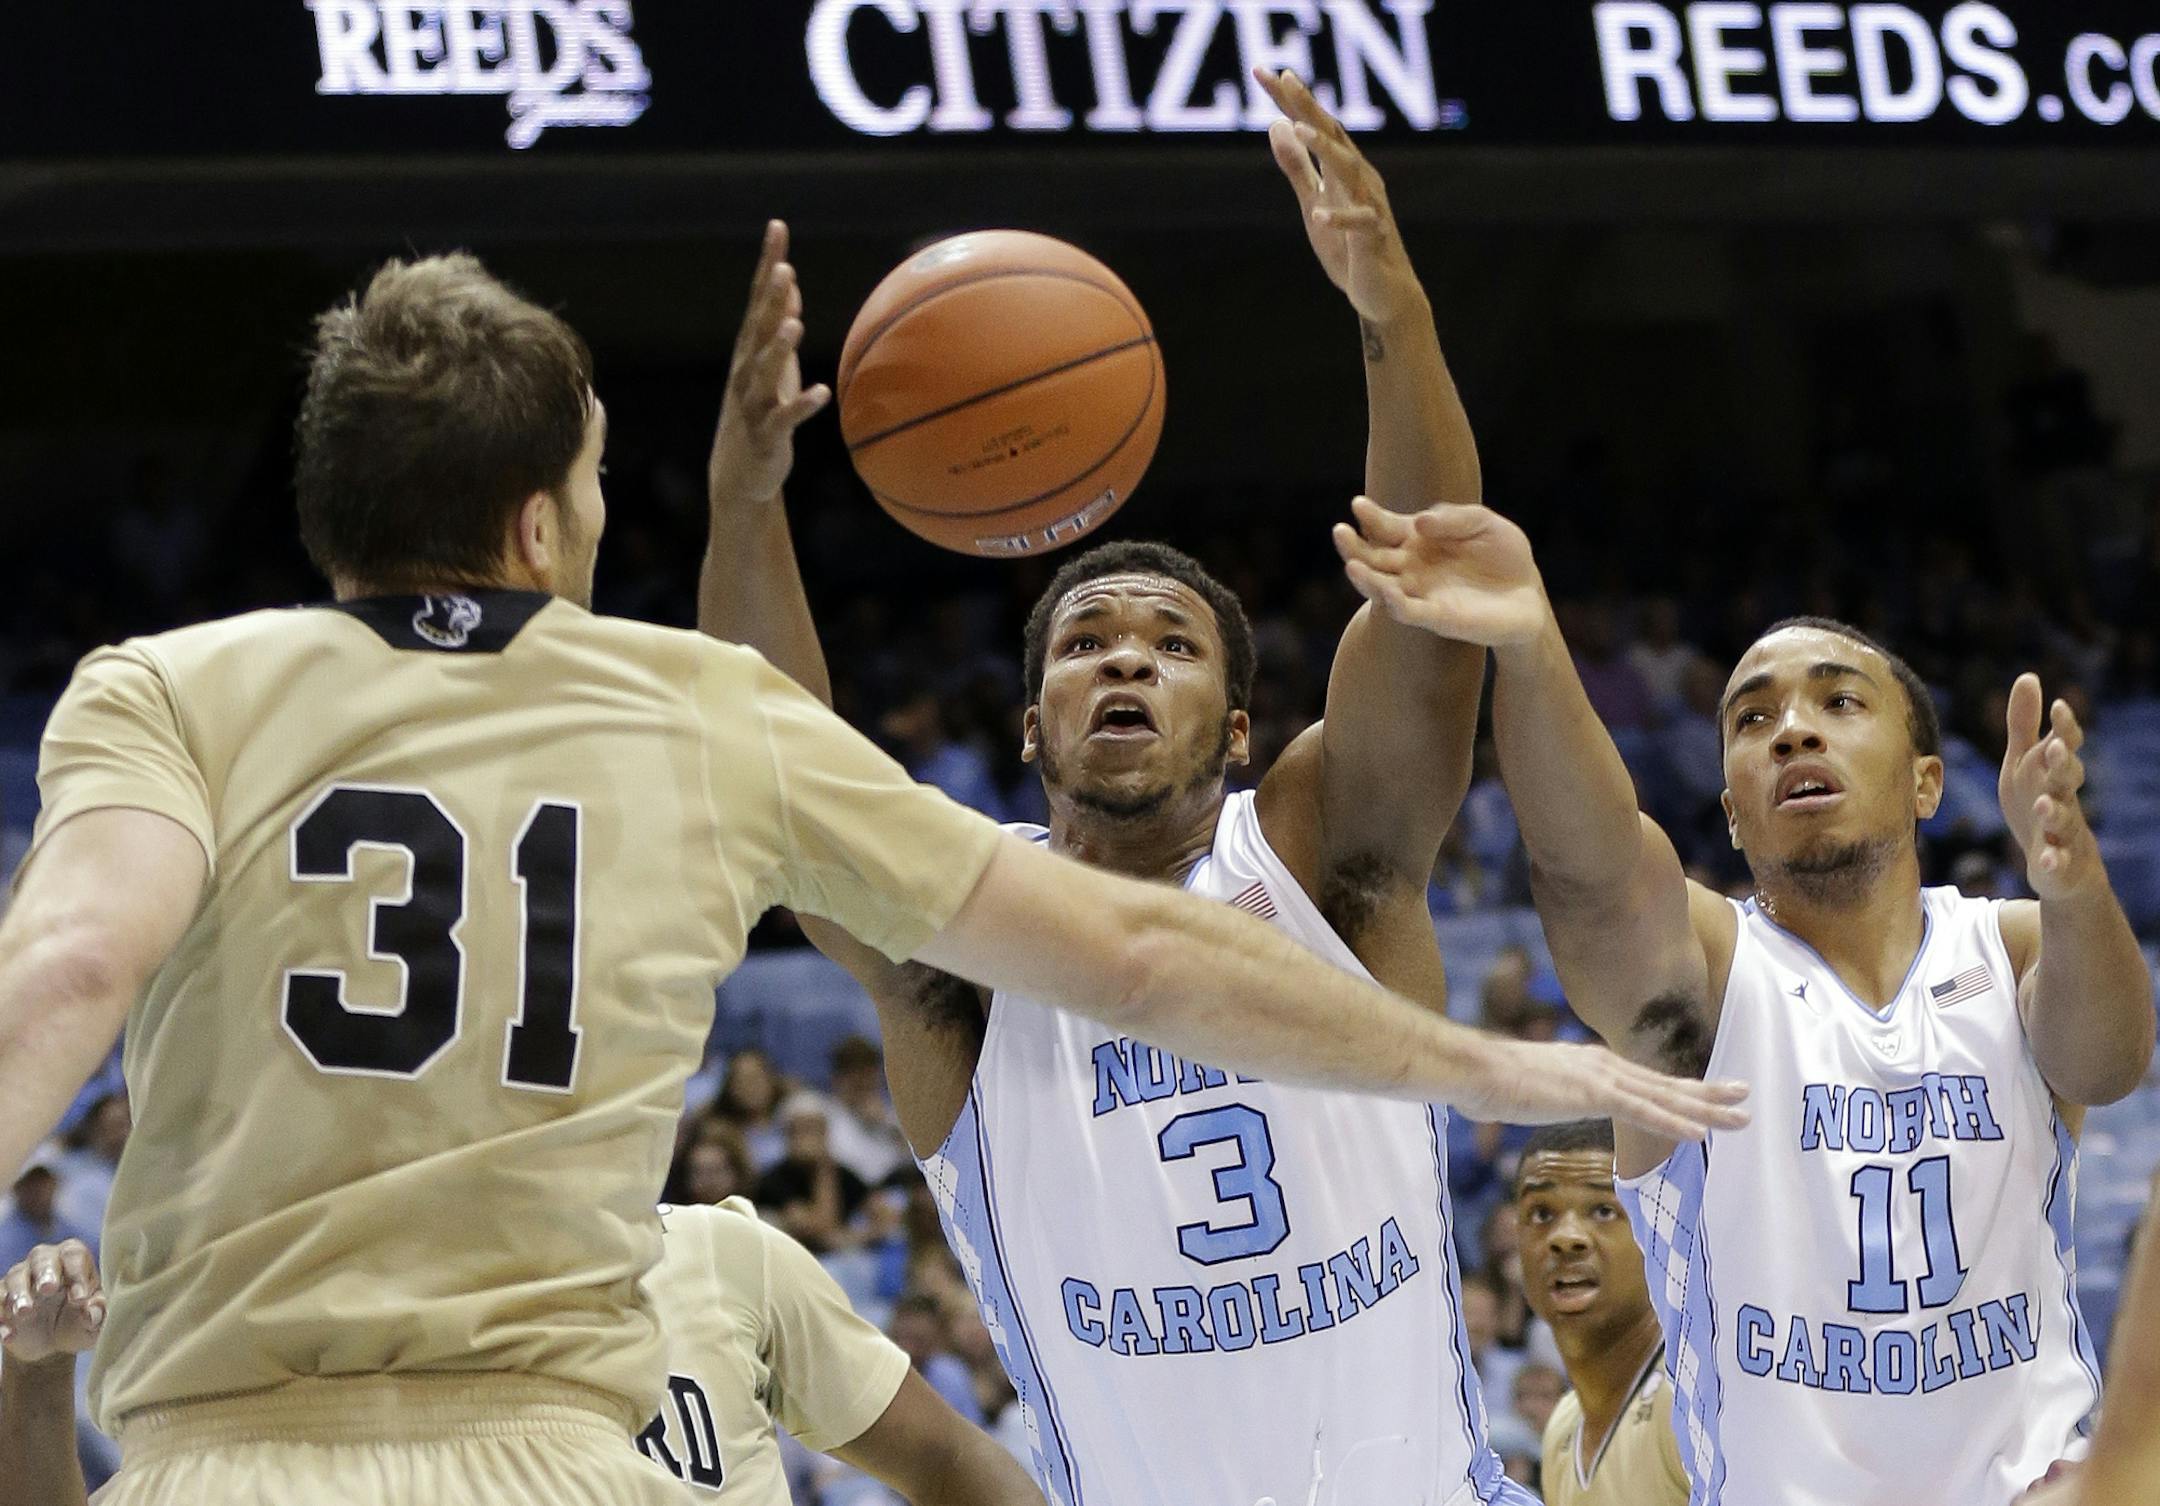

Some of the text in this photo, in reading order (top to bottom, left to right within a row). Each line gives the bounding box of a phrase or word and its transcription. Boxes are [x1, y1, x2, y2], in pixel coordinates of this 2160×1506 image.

[313, 0, 652, 95] REEDS
[805, 0, 1438, 136] CITIZEN
[280, 782, 583, 1095] 31
[1801, 1072, 2004, 1154] NORTH
[1157, 1103, 1291, 1266] 3
[1847, 1155, 1969, 1314] 11
[1060, 1216, 1420, 1356] CAROLINA
[1737, 1286, 2042, 1396] CAROLIN
